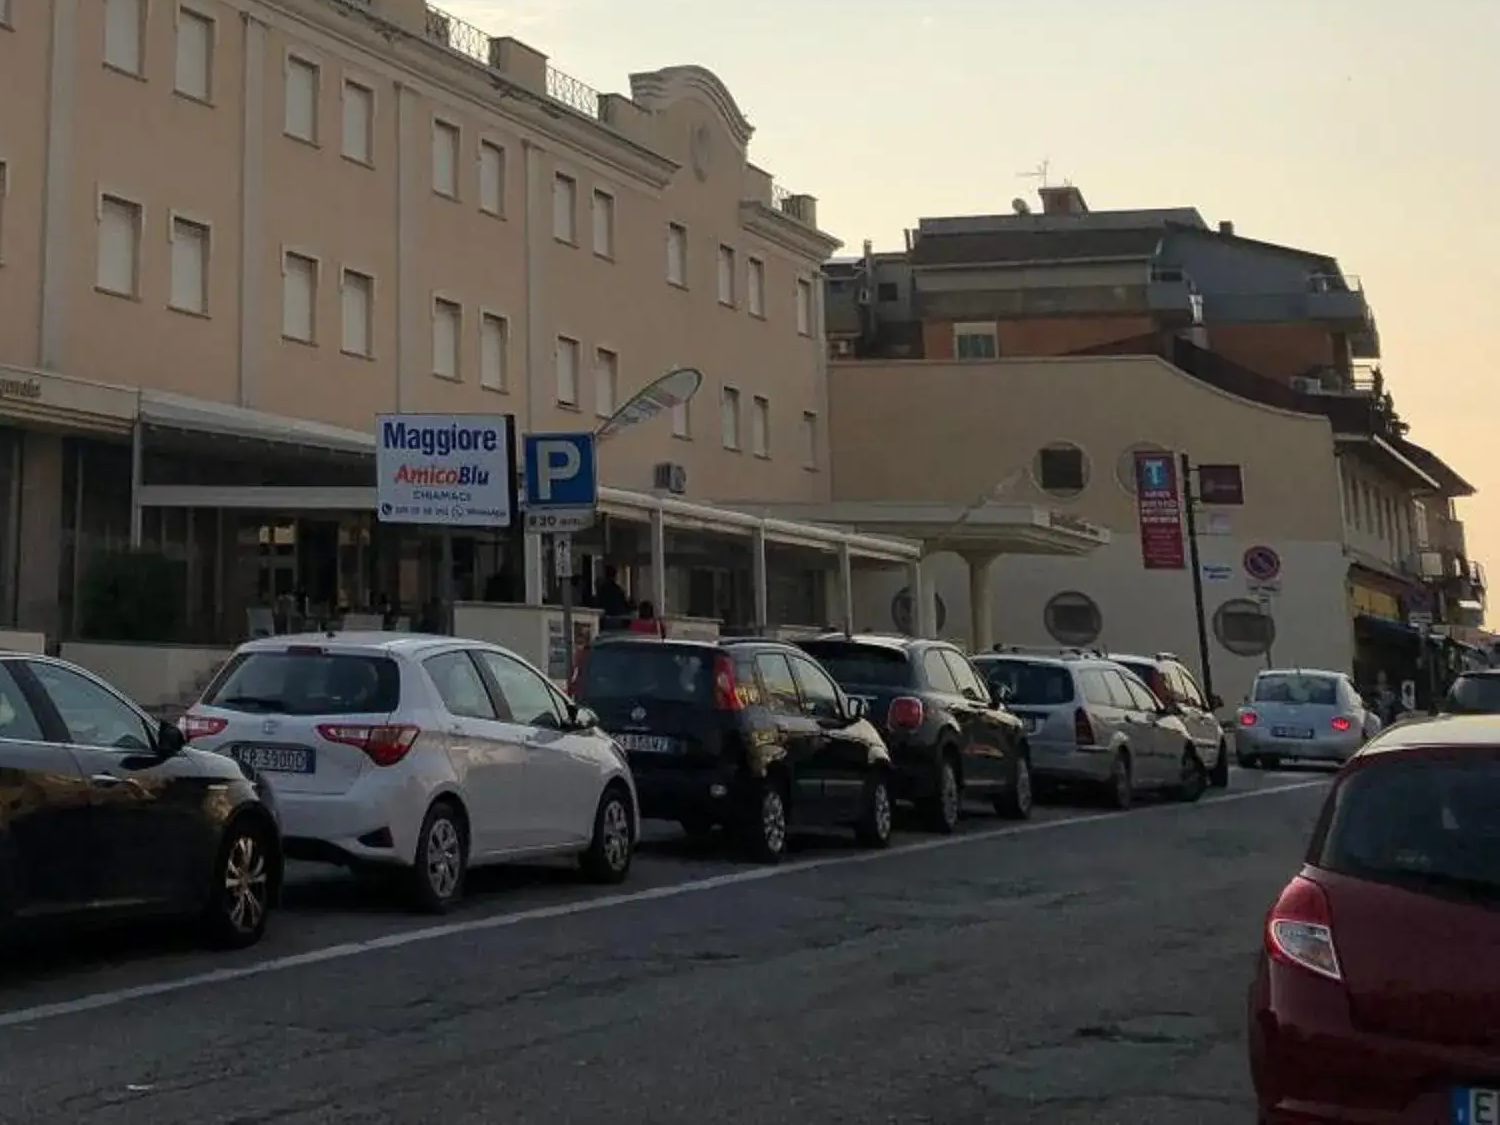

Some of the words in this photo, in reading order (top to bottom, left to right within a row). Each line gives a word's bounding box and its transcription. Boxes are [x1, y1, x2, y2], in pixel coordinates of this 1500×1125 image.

[383, 421, 497, 457] Maggiore
[393, 464, 490, 486] AmicoBlu
[535, 440, 581, 500] P
